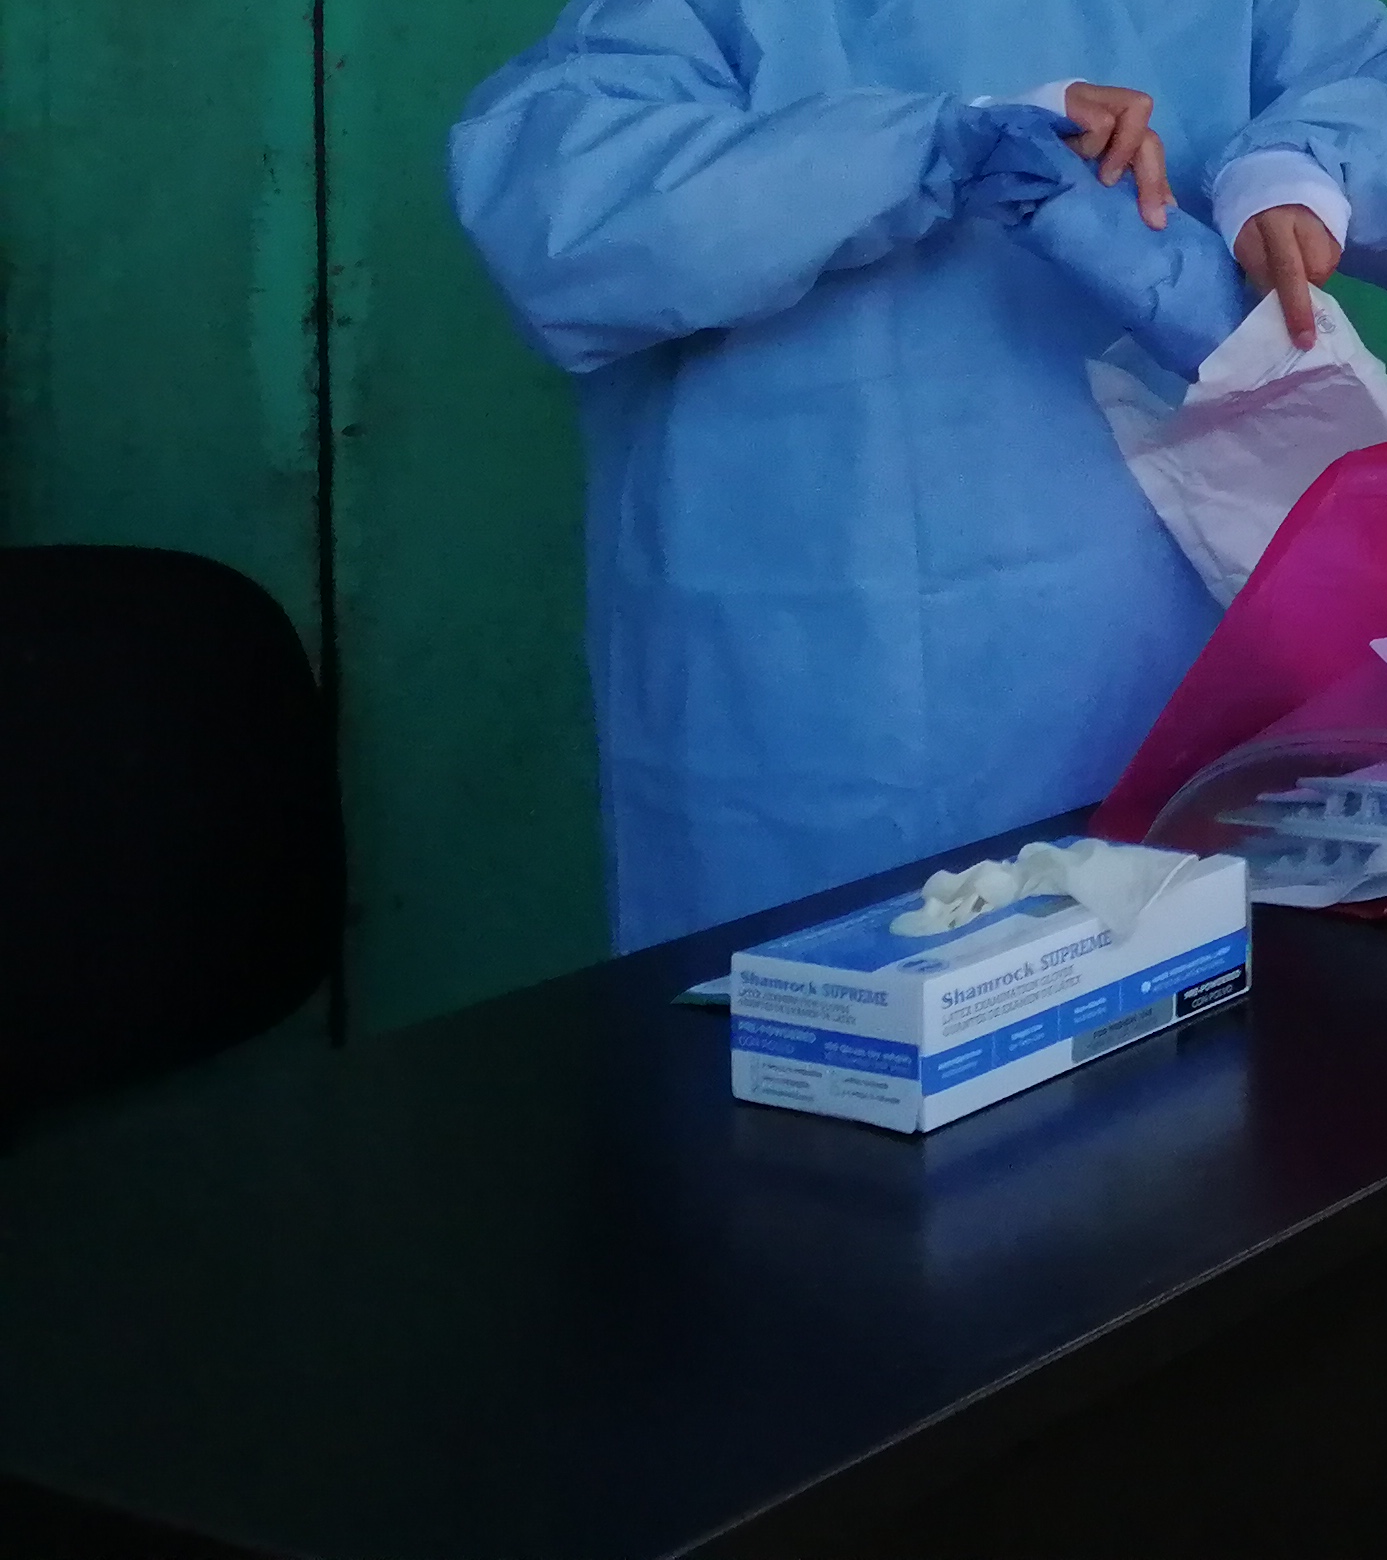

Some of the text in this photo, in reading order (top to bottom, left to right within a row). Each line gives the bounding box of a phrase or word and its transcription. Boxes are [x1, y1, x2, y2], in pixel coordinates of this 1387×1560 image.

[740, 970, 817, 996] Shamrock
[821, 982, 889, 1007] SUPREME
[942, 961, 1035, 1010] Shamrock
[1040, 930, 1113, 971] SUPREME
